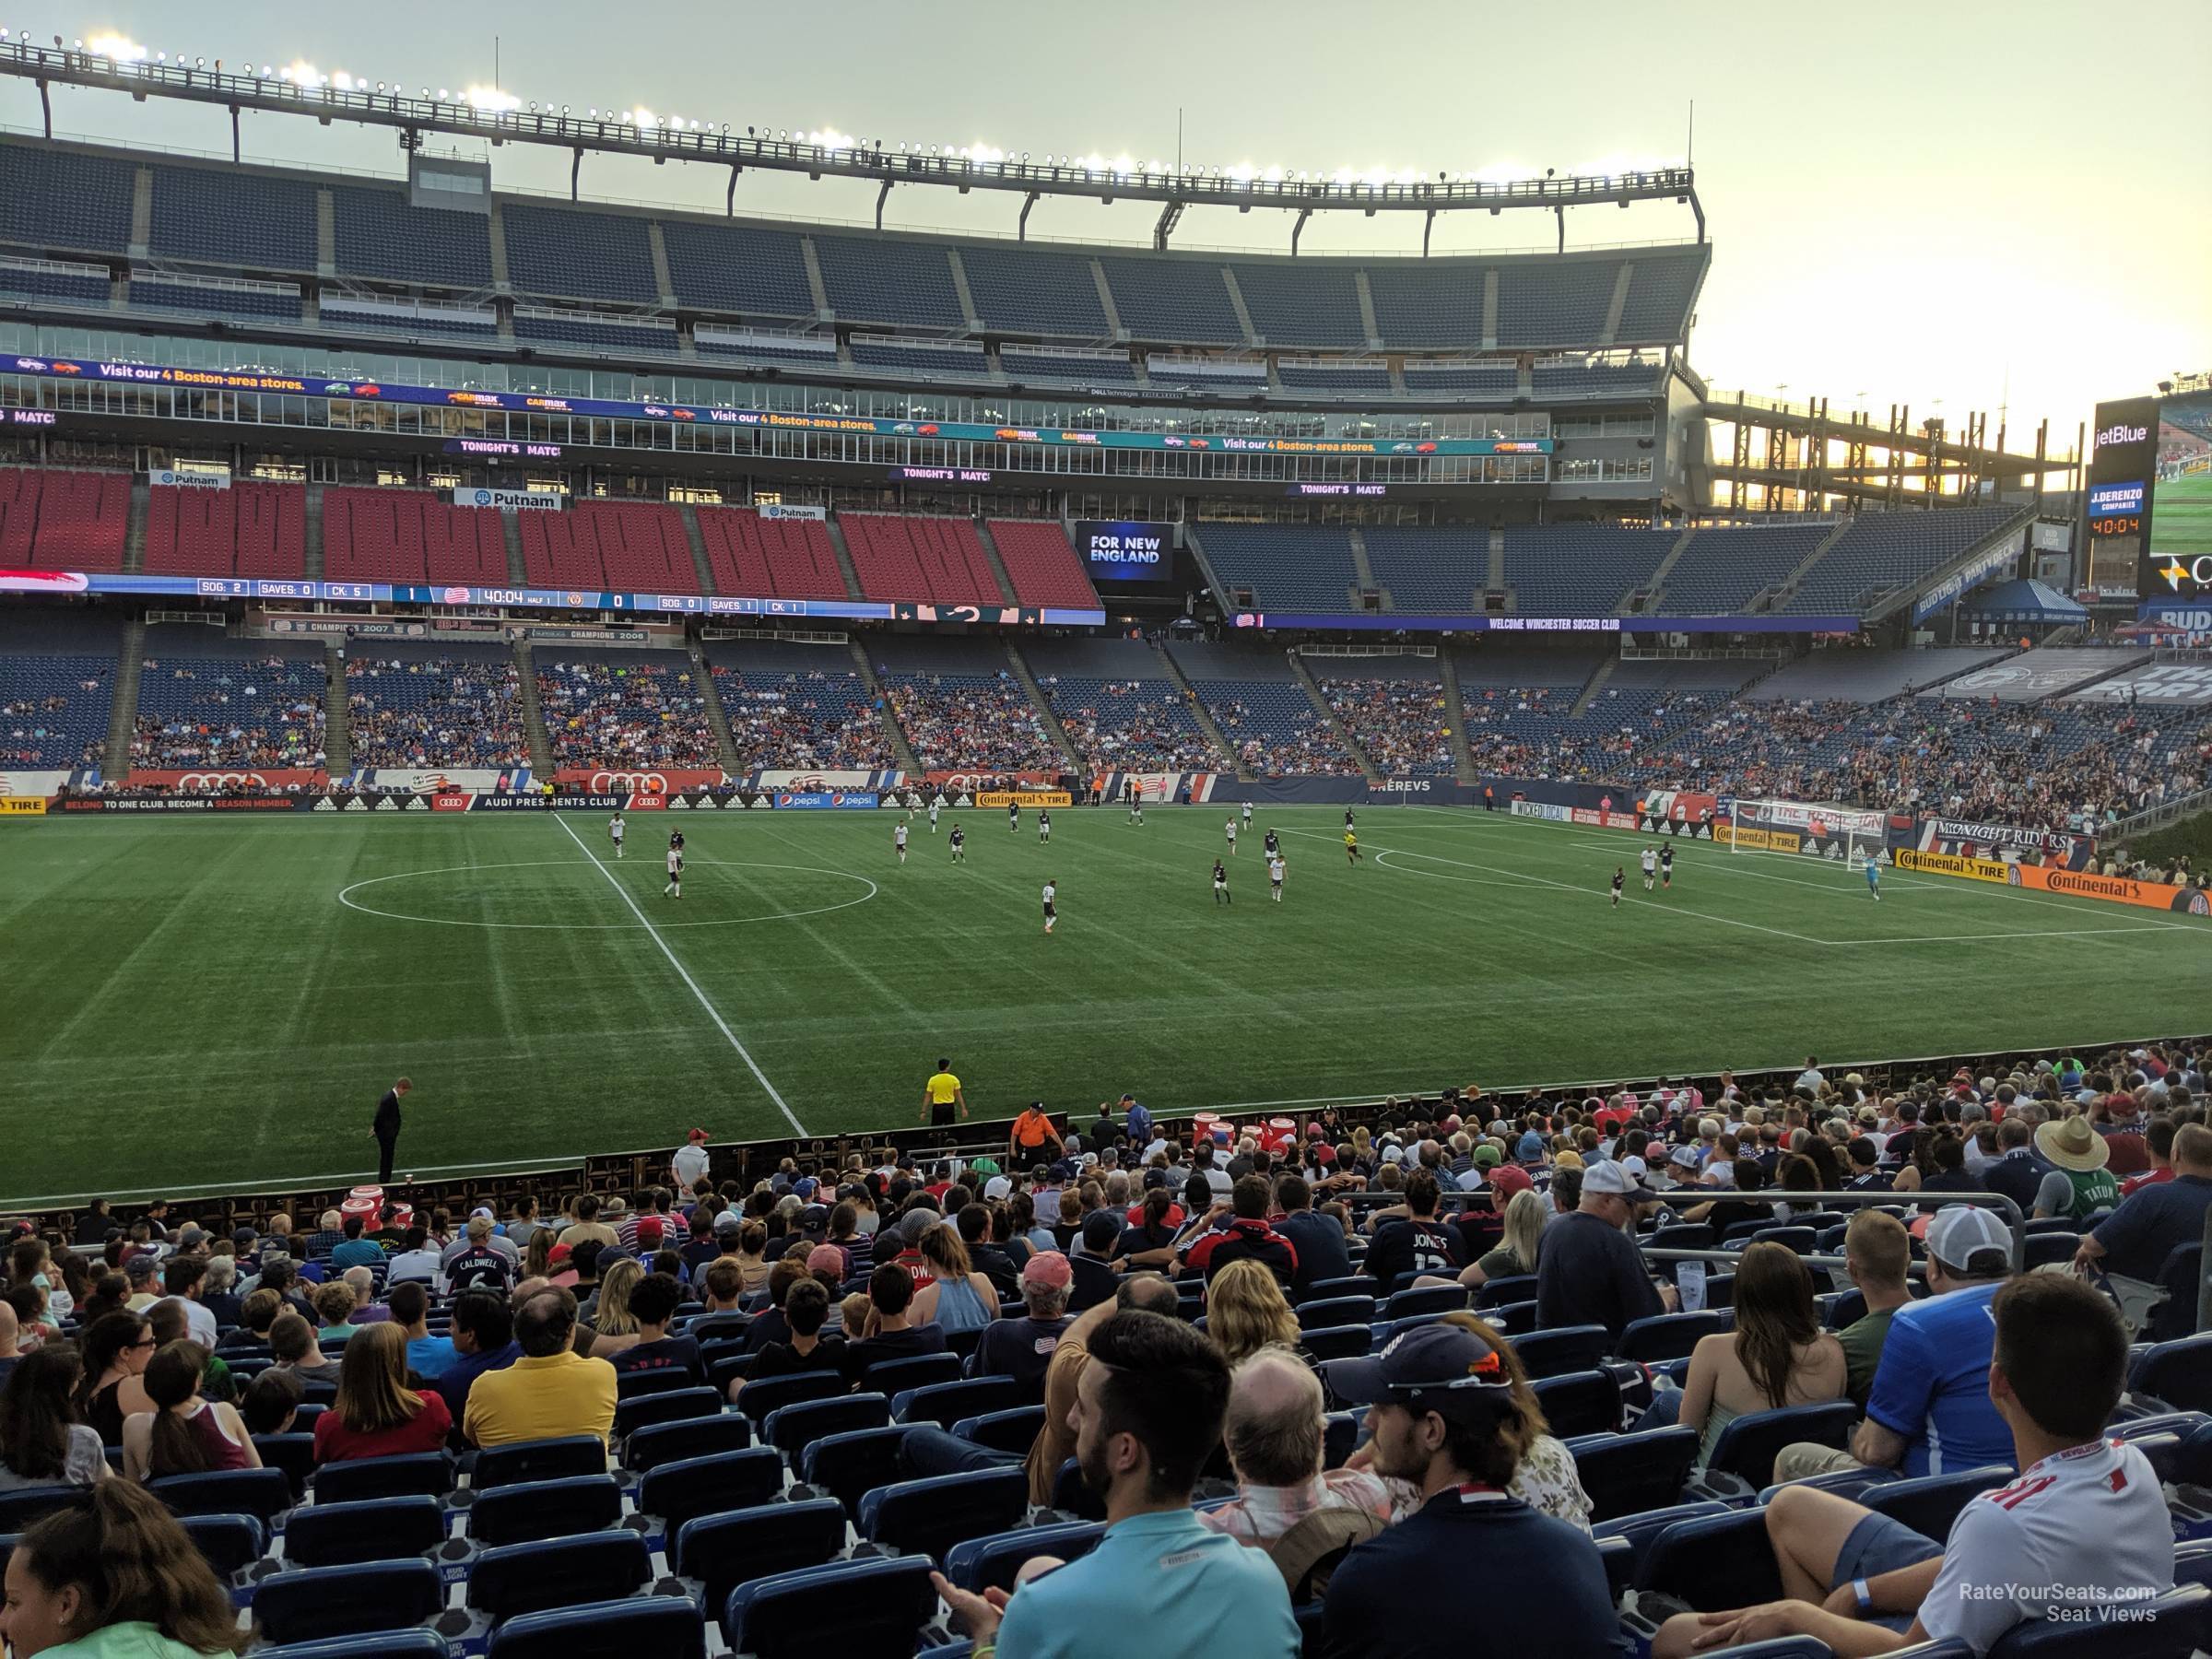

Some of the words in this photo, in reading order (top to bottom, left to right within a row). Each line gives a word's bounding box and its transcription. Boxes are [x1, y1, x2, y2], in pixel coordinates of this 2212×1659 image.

[100, 364, 133, 378] Visit
[135, 369, 160, 380] our
[162, 371, 171, 380] 4
[174, 371, 259, 388] Boston-area
[260, 376, 305, 390] stores.
[711, 410, 736, 422] Visit
[739, 413, 759, 423] our
[760, 414, 768, 424] 4
[771, 415, 839, 429] Boston-area
[840, 418, 877, 430] stores.
[2095, 425, 2145, 449] jetBlue
[461, 441, 519, 453] TONIGHT'S
[1222, 439, 1246, 450] Visit
[1248, 441, 1266, 450] our
[1268, 441, 1276, 451] 4
[1277, 441, 1339, 453] Boston-area
[1341, 442, 1376, 453] stores.
[903, 468, 954, 479] TONIGHT'S
[175, 475, 218, 486] Putnam
[1300, 484, 1349, 494] TONIGHT'S
[494, 493, 555, 507] Putnam
[2101, 501, 2136, 511] COMPANIES
[781, 509, 816, 517] Putnam
[2092, 518, 2138, 535] 40:04
[1091, 536, 1119, 548] FOR
[1125, 537, 1160, 550] NEW
[1091, 550, 1159, 563] ENGLAND
[202, 582, 226, 593] SOG:
[234, 583, 241, 593] 2
[262, 583, 296, 594] SAVES:
[303, 585, 311, 595] 0
[333, 586, 347, 596] CK:
[1920, 591, 1937, 612] BUD
[1936, 574, 1963, 602] LIGHT
[484, 590, 524, 604] 40:04
[614, 595, 622, 606] 0
[662, 598, 682, 608] SOG:
[688, 598, 695, 608] 0
[712, 600, 742, 610] SAVES:
[771, 603, 784, 611] CK:
[1489, 618, 1524, 629] WELCOME
[1526, 618, 1571, 629] WINCHESTER
[1573, 619, 1600, 629] SOCCER
[1601, 619, 1619, 630] CLUB
[2161, 611, 2212, 630] BUD
[311, 622, 359, 632] CHAMPIS
[571, 630, 615, 640] CHAMPIONS
[10, 801, 41, 810] TIRE
[65, 801, 103, 809] BELONG
[168, 800, 205, 808] BECOME
[486, 798, 512, 806] AUDI
[516, 798, 585, 806] PRESDENTS
[794, 796, 820, 806] pepsi
[846, 796, 872, 805] pepsi
[1938, 821, 2011, 841] MIDNIGHT
[2014, 830, 2066, 849] RIDRS
[1776, 837, 1797, 847] TIRE
[1900, 851, 1964, 873] Continental
[1977, 865, 2005, 878] TIRE
[2047, 871, 2127, 897] Continental
[2085, 1185, 2113, 1202] TATUM
[1413, 1233, 1447, 1249] JONES
[460, 1258, 498, 1270] CALDWELL
